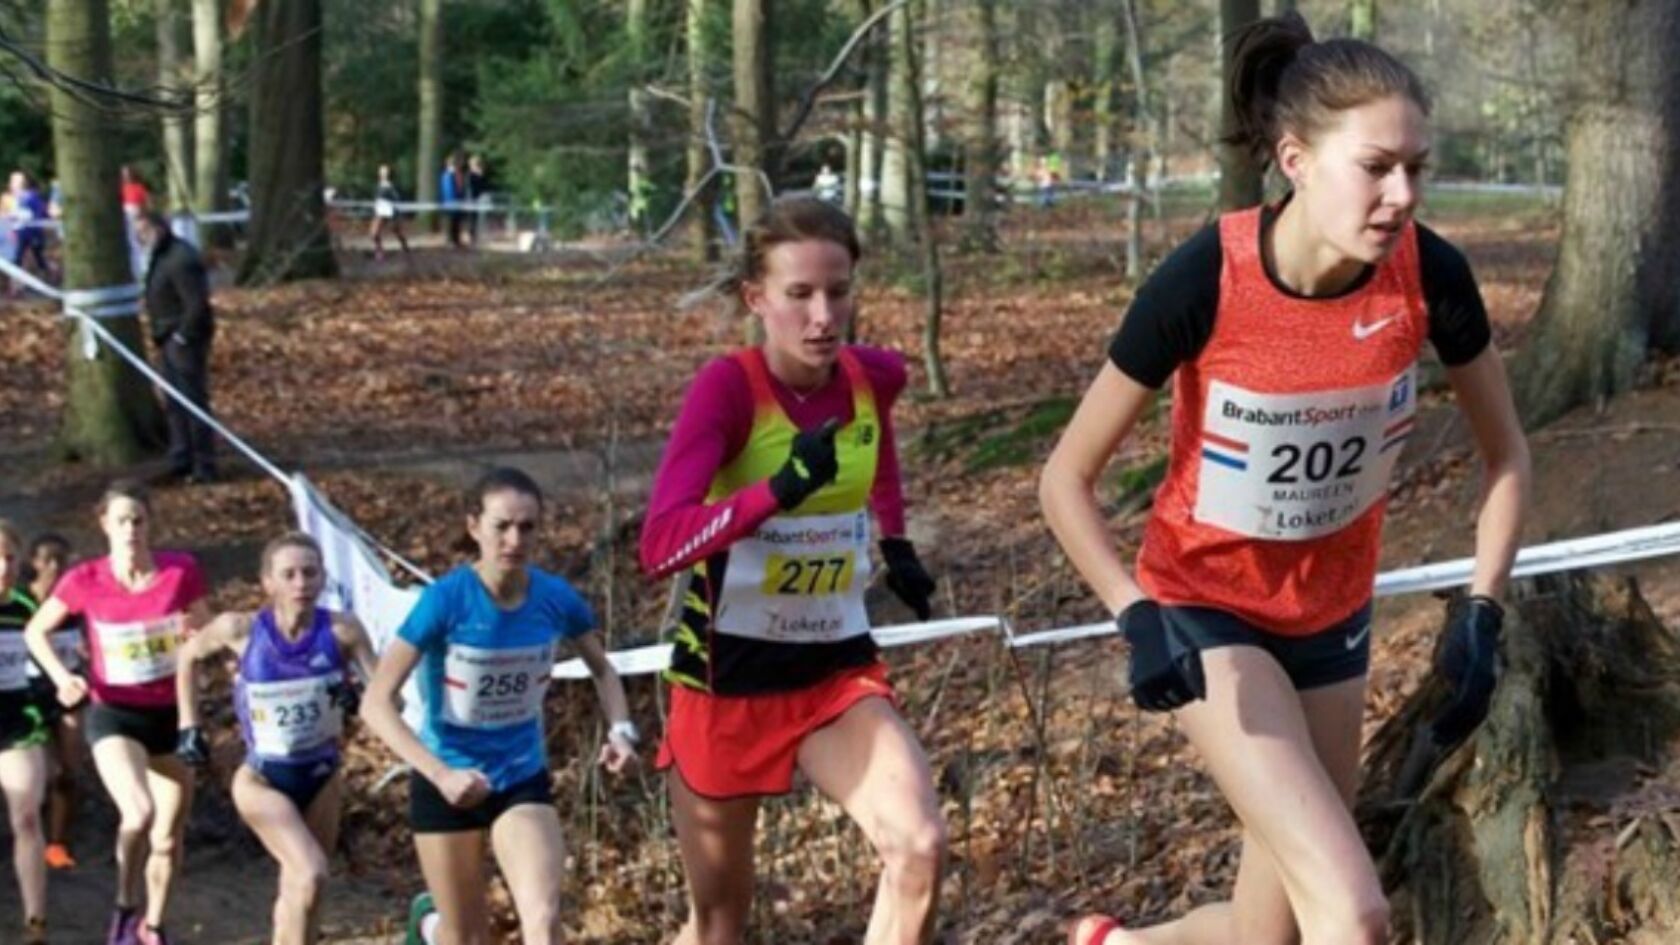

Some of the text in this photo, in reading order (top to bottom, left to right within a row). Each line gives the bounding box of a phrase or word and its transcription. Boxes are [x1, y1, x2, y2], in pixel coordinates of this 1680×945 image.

[1221, 400, 1355, 428] BrabantSport
[1267, 436, 1366, 484] 202
[1273, 484, 1354, 501] MAUREEN
[757, 528, 838, 546] rabantSport
[778, 558, 846, 595] 277
[477, 671, 529, 697] 258
[274, 700, 321, 727] 233
